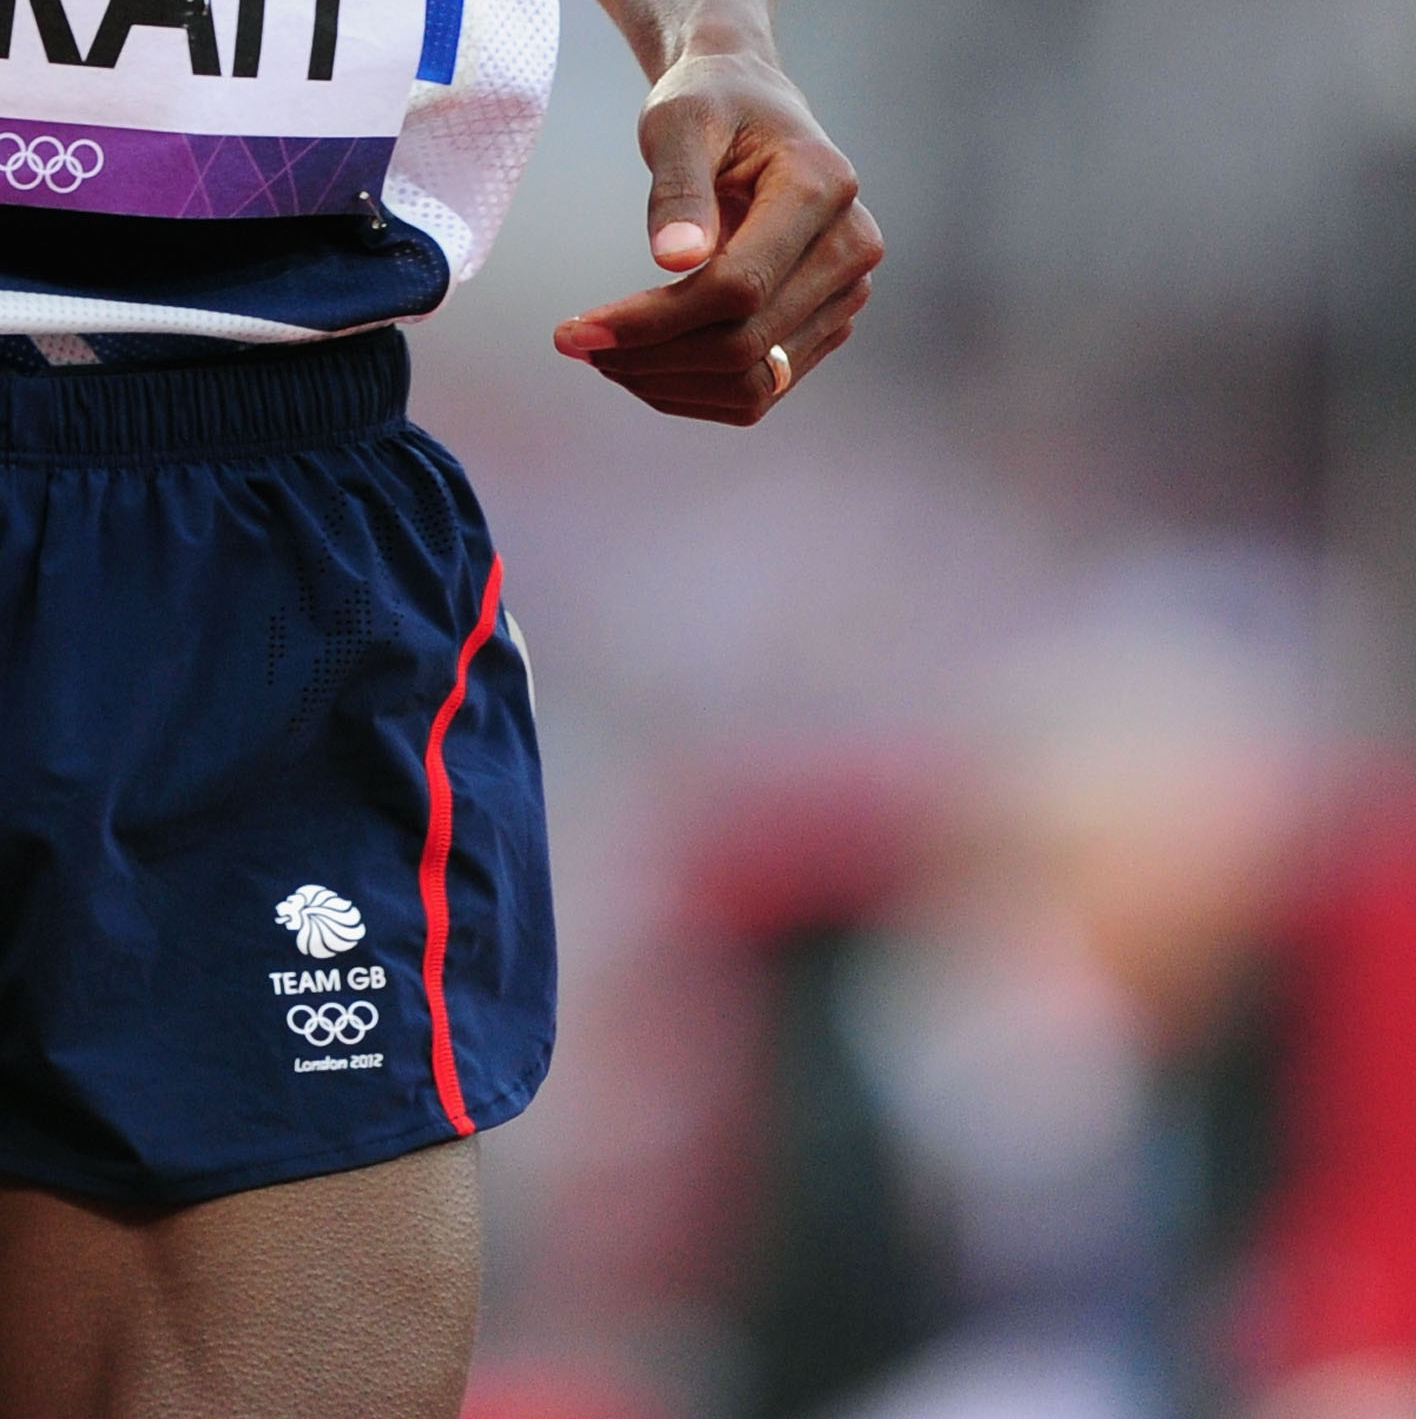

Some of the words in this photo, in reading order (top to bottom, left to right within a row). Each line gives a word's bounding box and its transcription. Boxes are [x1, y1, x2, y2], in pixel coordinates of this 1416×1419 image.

[268, 969, 341, 995] TEAM
[347, 966, 387, 990] GB
[294, 1055, 348, 1072] London
[350, 1053, 384, 1070] 2012
